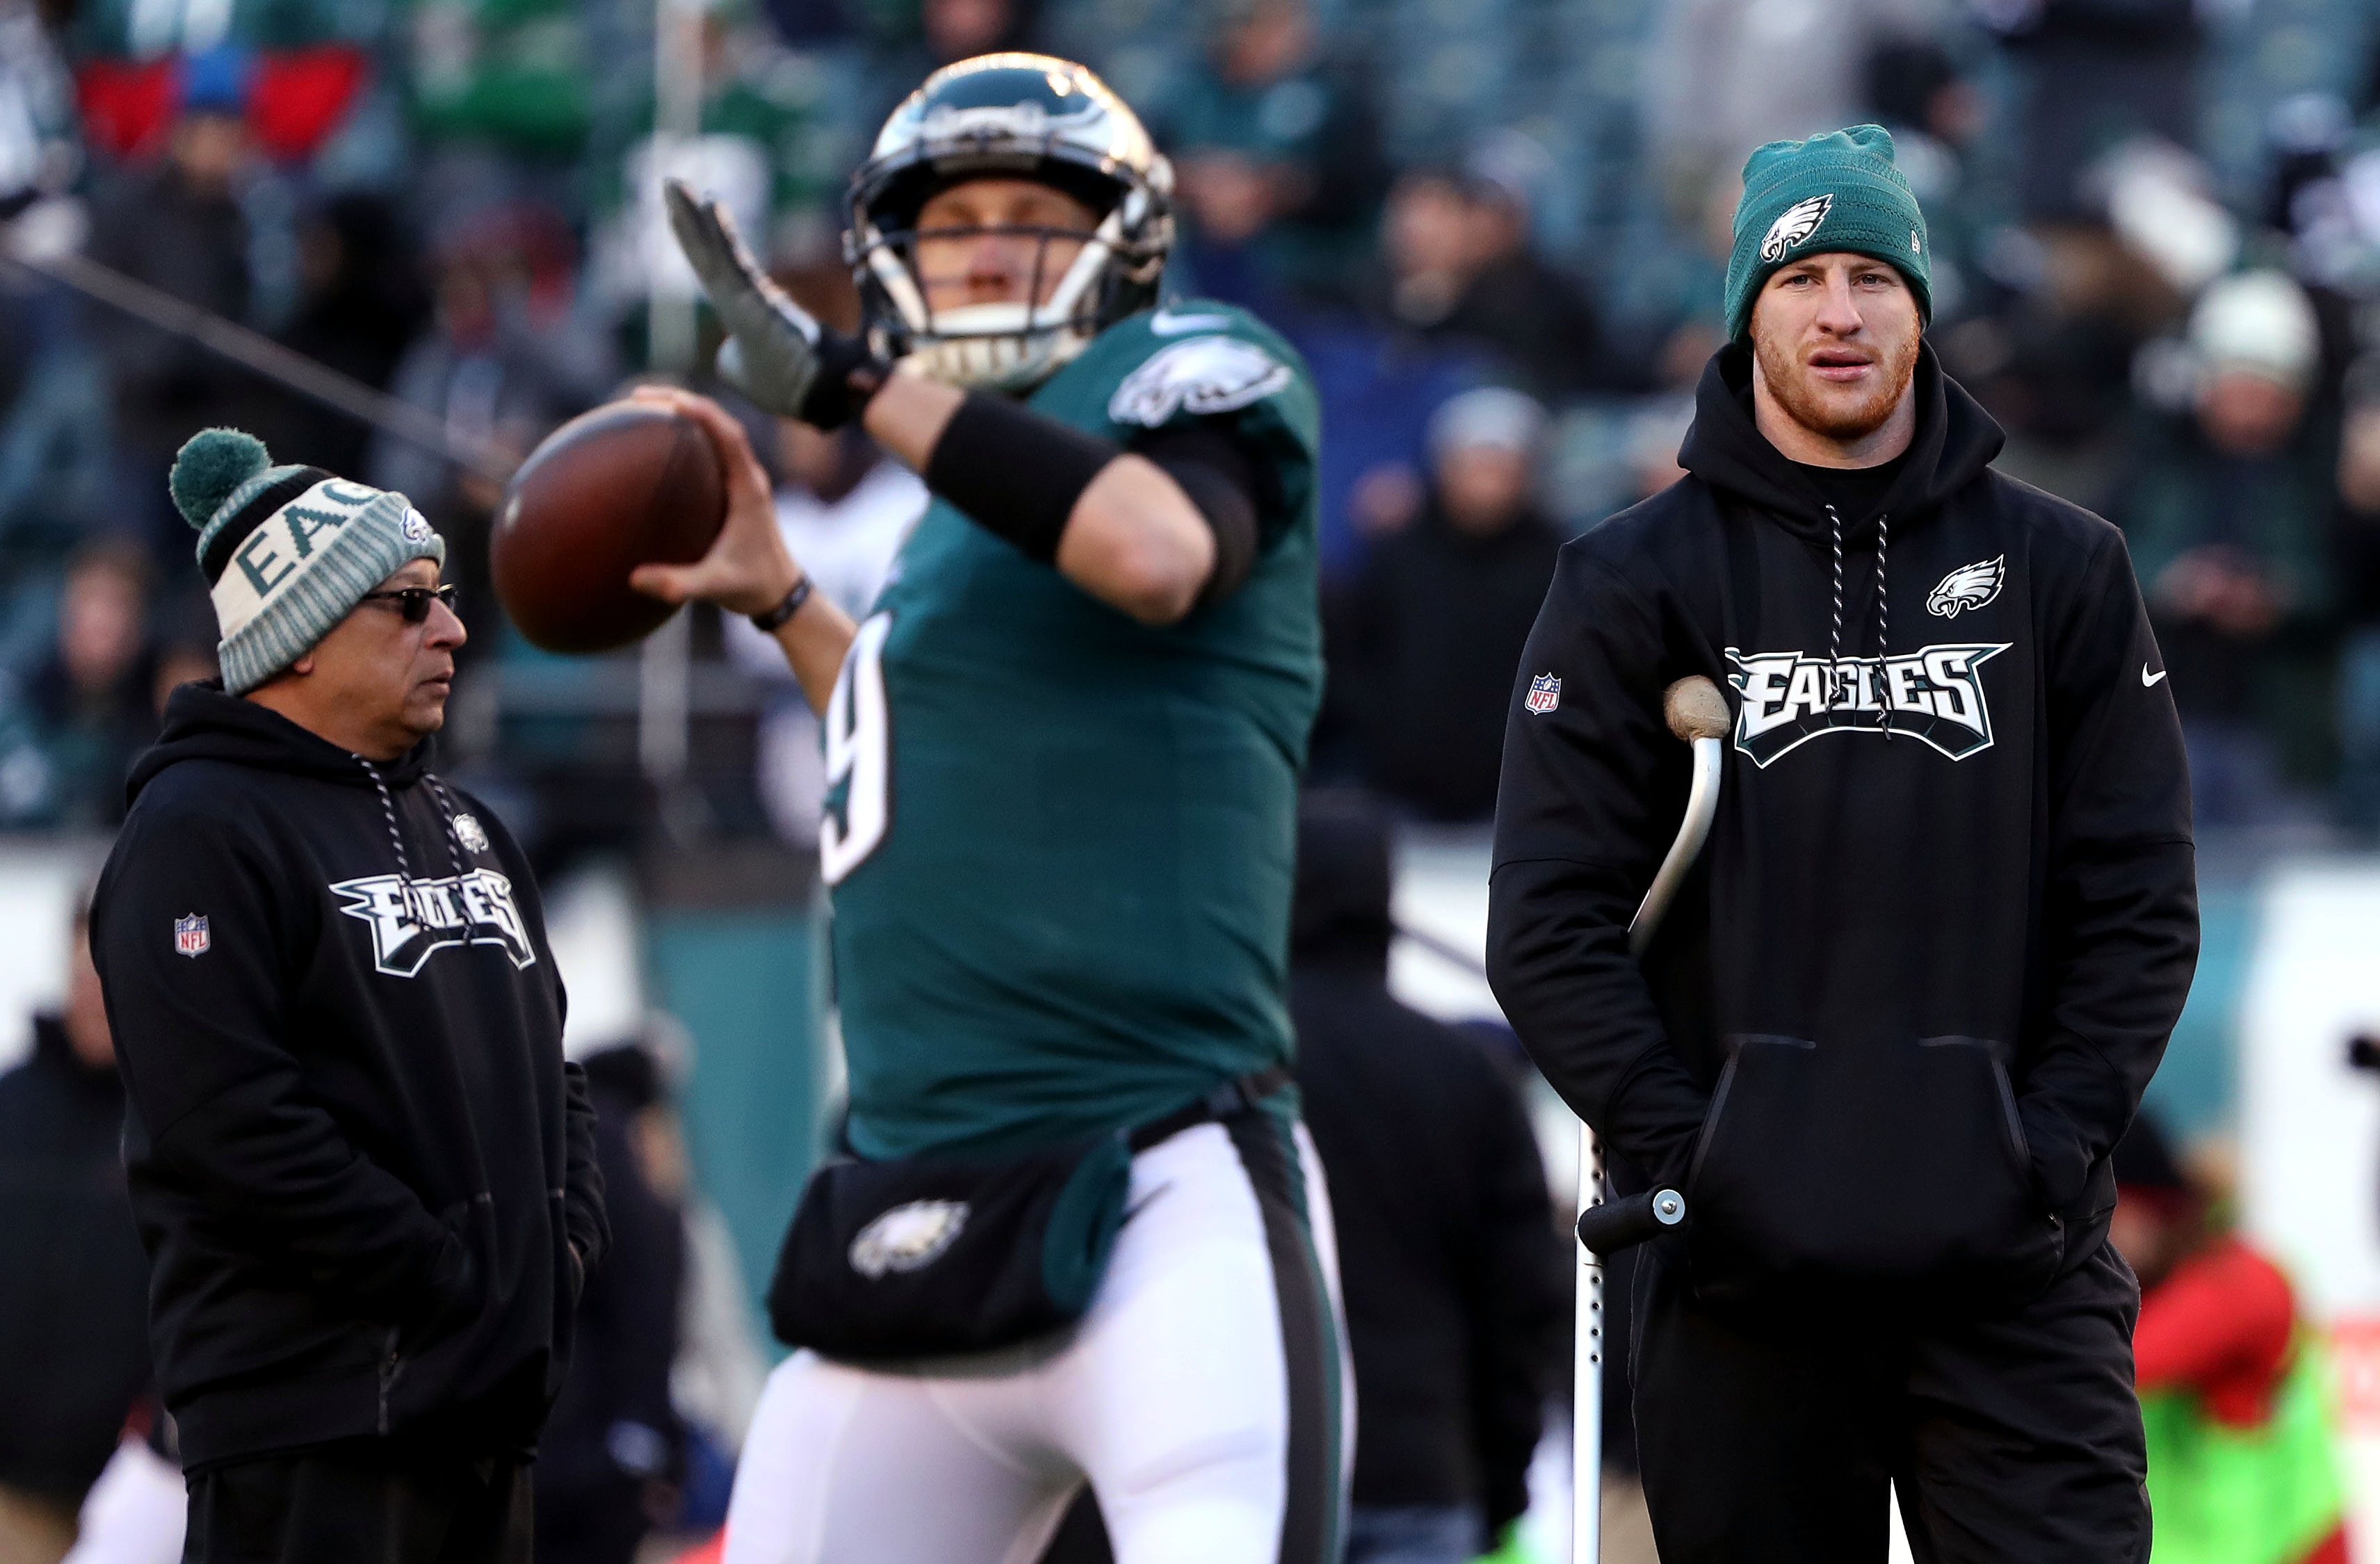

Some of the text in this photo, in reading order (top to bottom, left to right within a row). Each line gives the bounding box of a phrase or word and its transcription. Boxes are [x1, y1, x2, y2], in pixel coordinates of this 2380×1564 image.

[1529, 691, 1555, 709] NFL
[1731, 647, 1994, 743] EAGLES
[820, 609, 895, 887] 9
[180, 931, 207, 951] NFL
